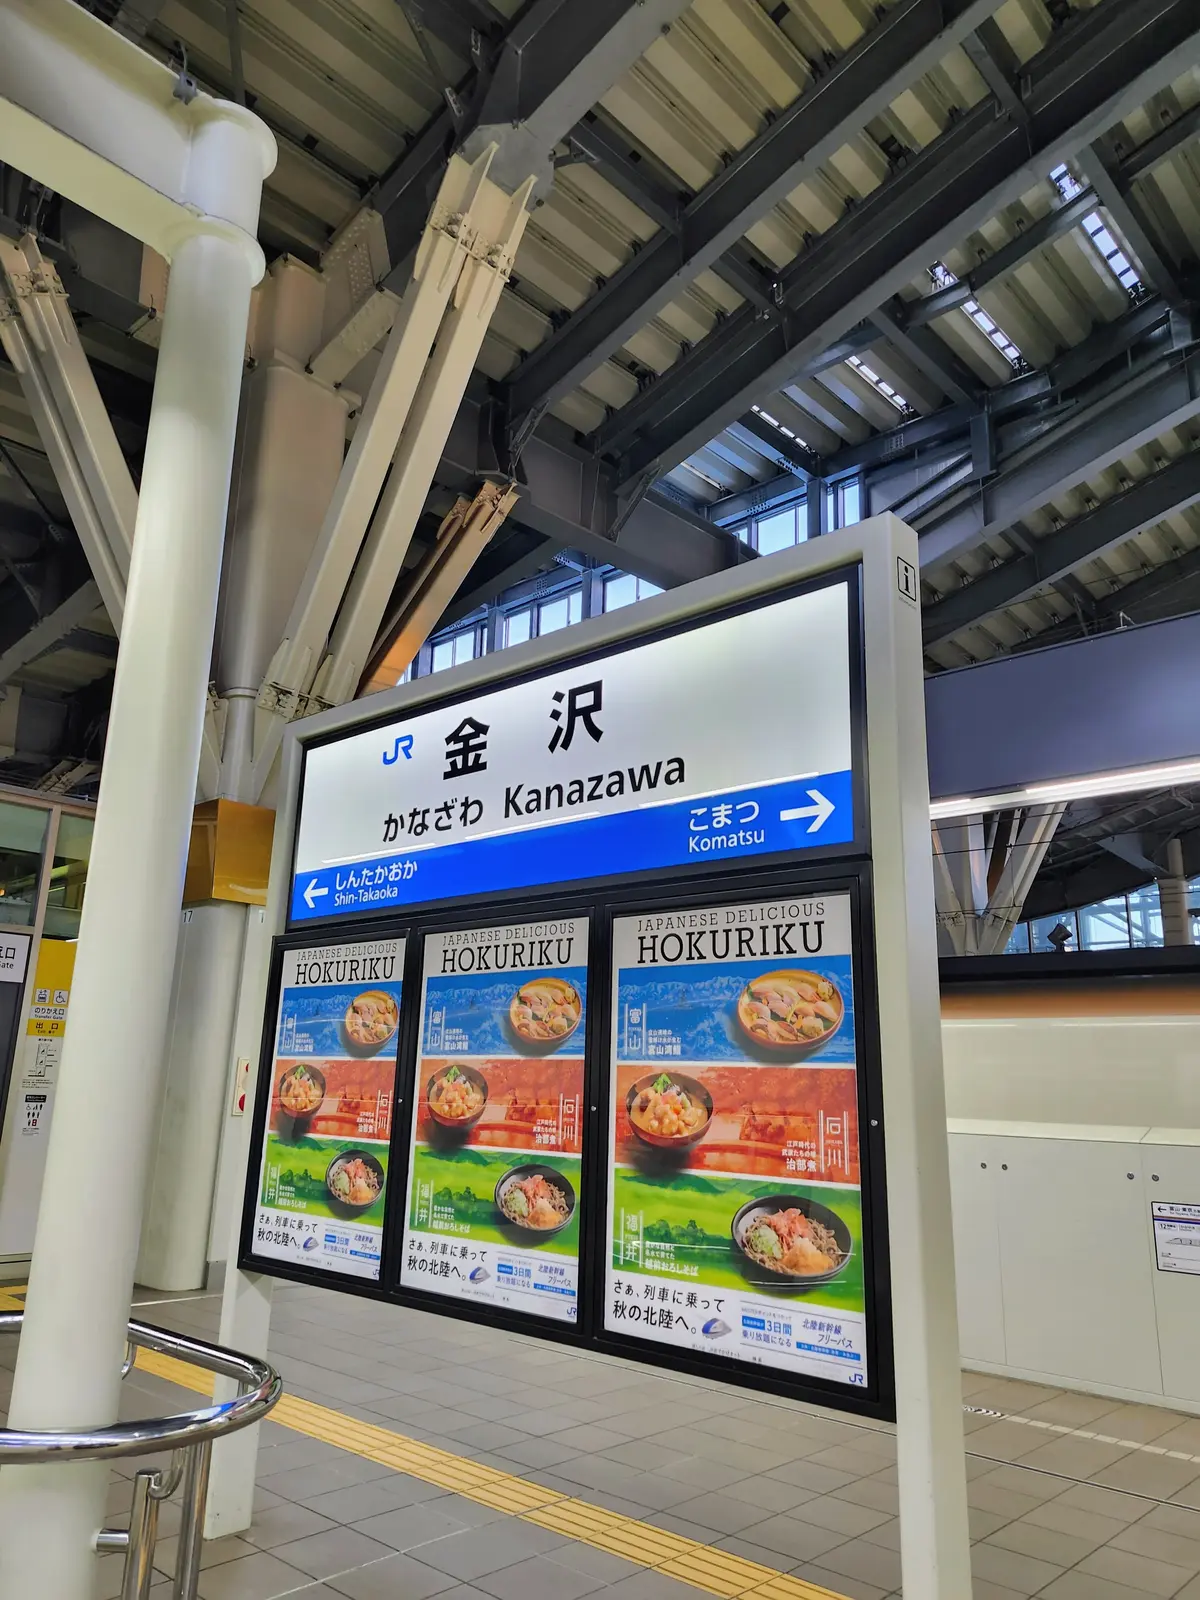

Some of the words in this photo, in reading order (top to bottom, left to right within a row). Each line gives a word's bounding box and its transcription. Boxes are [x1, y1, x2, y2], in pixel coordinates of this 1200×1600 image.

[382, 734, 413, 765] JR
[382, 796, 484, 842] かなざわ
[503, 756, 685, 818] Kanazawa
[689, 800, 760, 831] こまつ
[688, 829, 765, 853] Komatsu
[335, 860, 418, 890] しんたかおか
[334, 884, 398, 906] Shin-Takaoka
[183, 910, 193, 923] 17
[637, 913, 718, 932] JAPANESE
[725, 902, 825, 924] DELICIOUS
[443, 929, 501, 946] JAPANESE
[505, 922, 575, 940] DELICIOUS
[637, 921, 825, 964] HOKURIKU
[297, 948, 342, 961] JAPANESE
[344, 942, 398, 957] DELICIOUS
[441, 937, 574, 973] HOKURIKU
[0, 961, 14, 969] ate
[295, 956, 396, 985] HOKURIKU
[34, 1007, 65, 1015] のりかえ口
[786, 1158, 817, 1172] 治部煮
[257, 1227, 301, 1250] 秋の北陸へ。
[407, 1255, 466, 1281] 秋の北陸へ。
[513, 1267, 531, 1279] 3日間
[548, 1276, 572, 1288] フリーパス
[612, 1300, 697, 1334] 秋の北陸へ。
[766, 1320, 792, 1336] 3日間
[802, 1318, 842, 1335] 北陸新幹線
[742, 1330, 792, 1347] 乗り放題になる
[818, 1334, 853, 1349] フリーパス
[849, 1373, 864, 1384] JR
